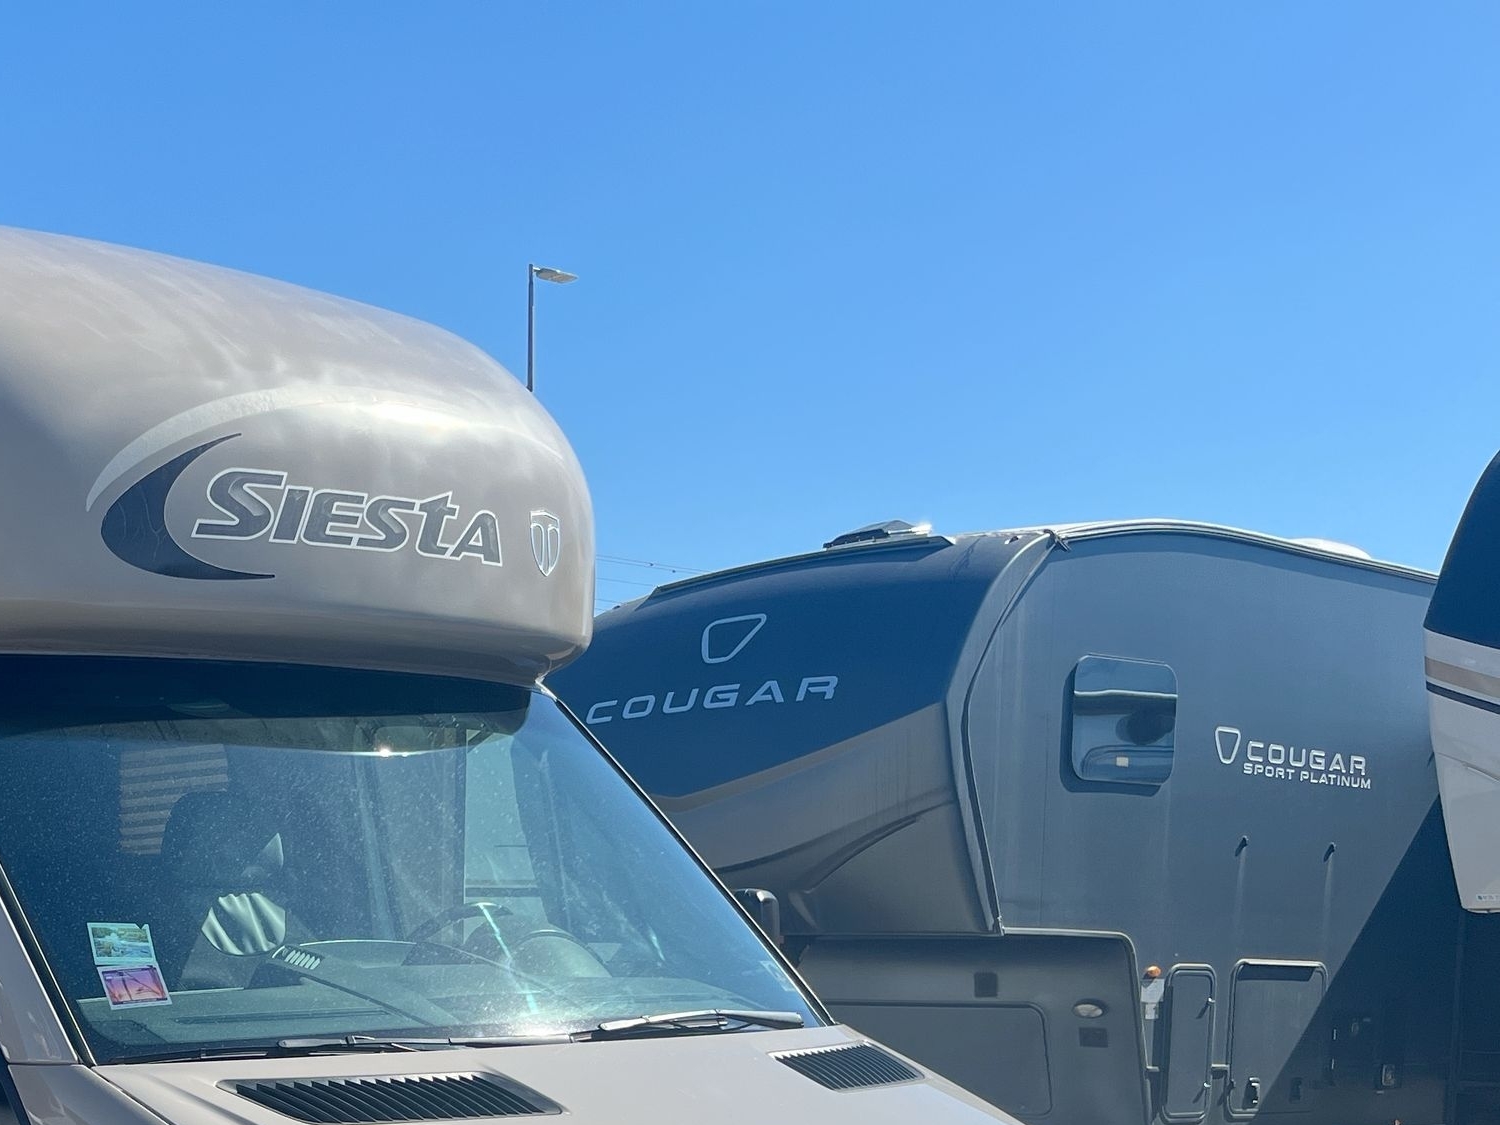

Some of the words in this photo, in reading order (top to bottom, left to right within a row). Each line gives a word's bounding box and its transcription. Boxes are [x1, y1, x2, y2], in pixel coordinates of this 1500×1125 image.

[586, 675, 838, 725] COUGAR
[1247, 740, 1366, 775] COUGAR
[1243, 762, 1295, 779] SPORT
[1300, 770, 1371, 789] PLATINUM
